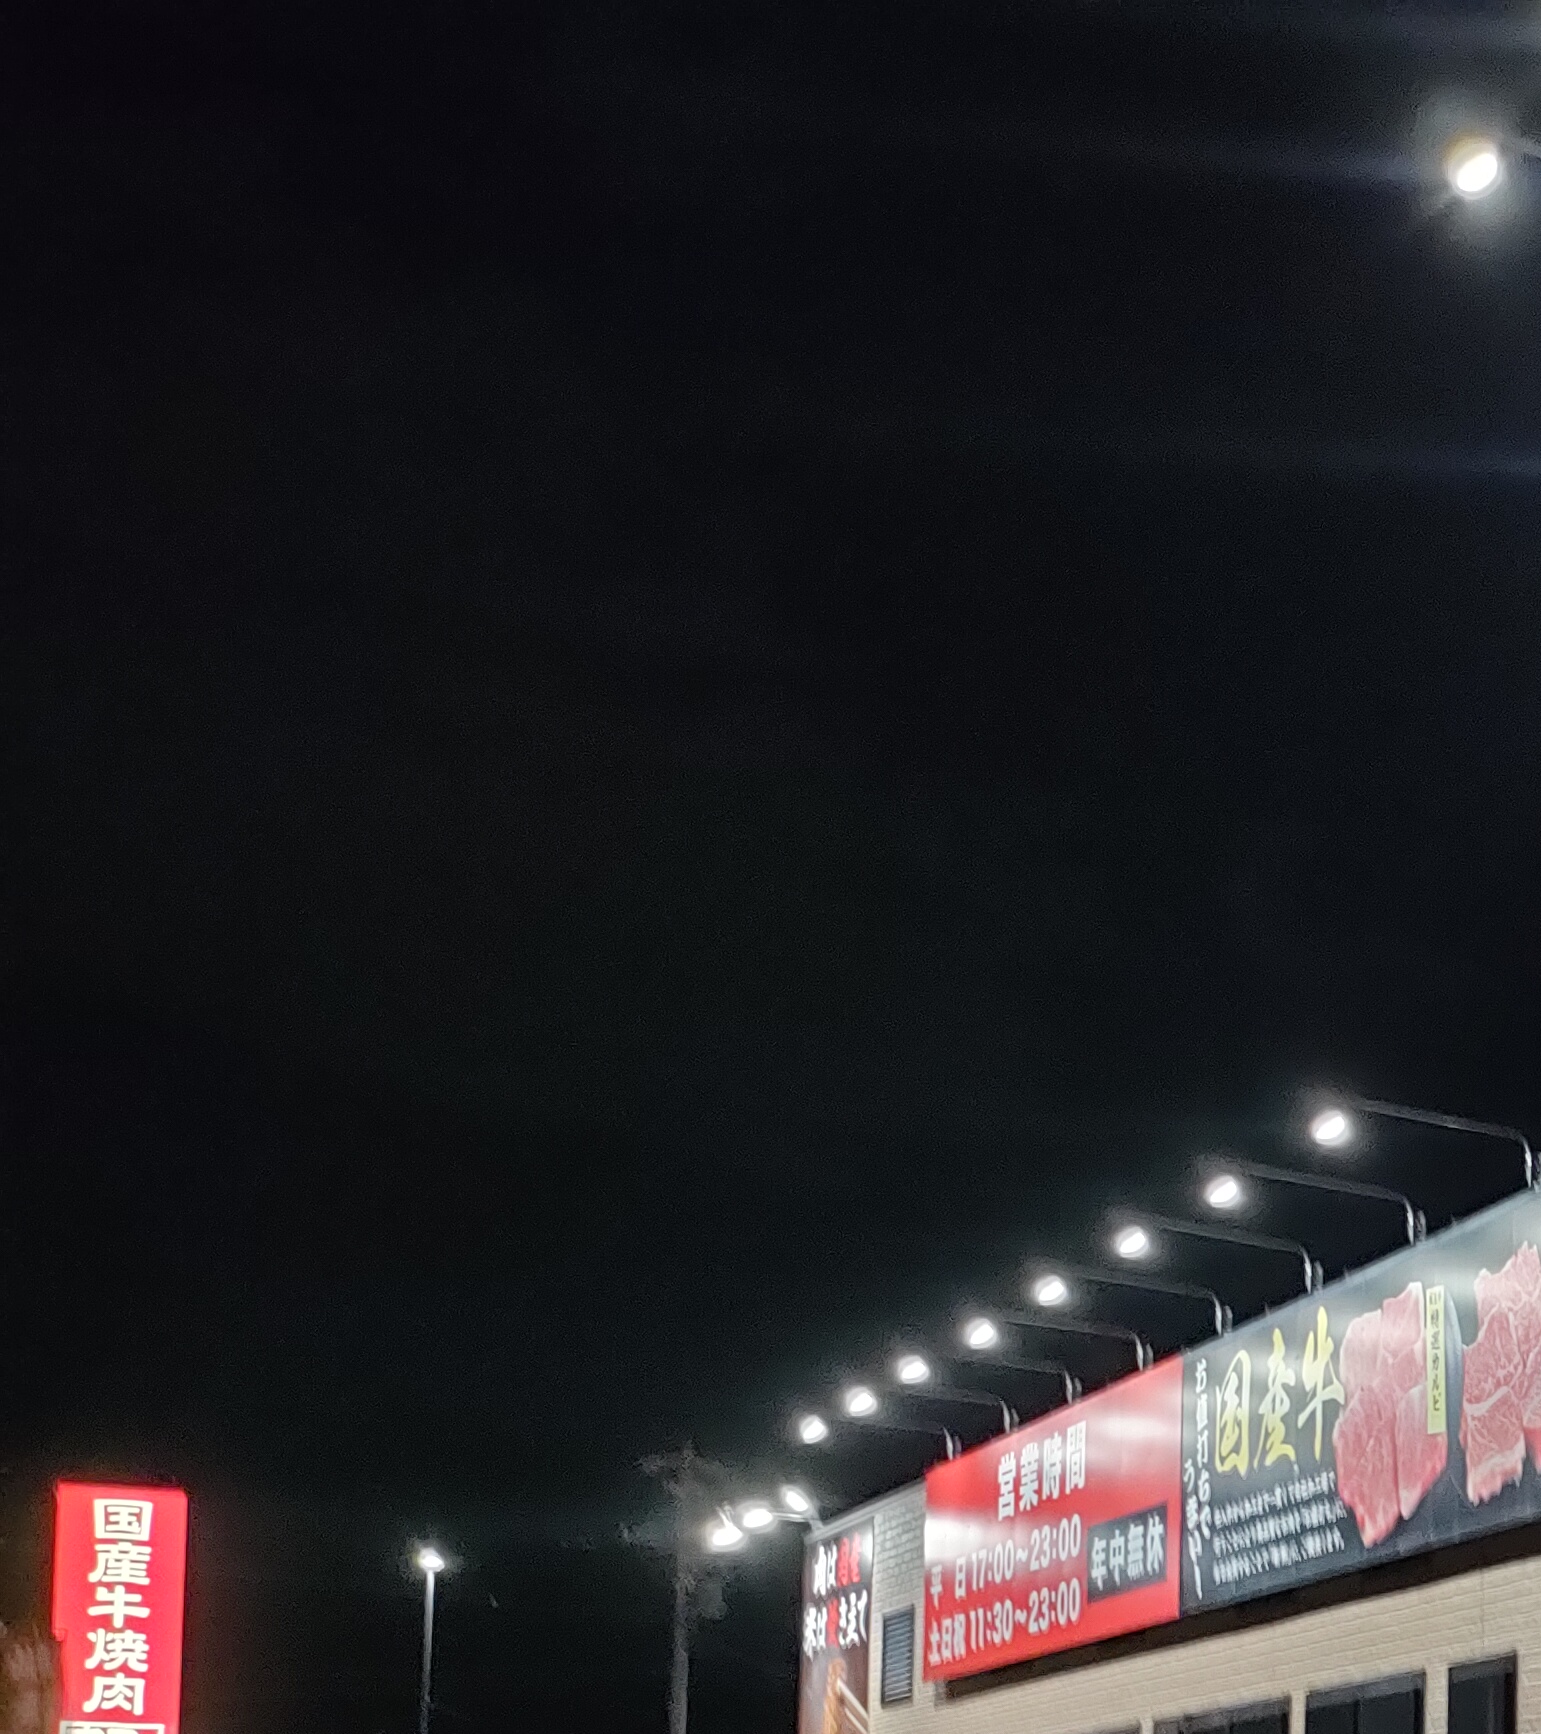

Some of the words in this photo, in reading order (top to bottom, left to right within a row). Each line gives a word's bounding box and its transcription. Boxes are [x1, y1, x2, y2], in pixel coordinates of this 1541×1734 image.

[1214, 1306, 1345, 1480] 国産牛
[997, 1420, 1087, 1522] 営業時間
[82, 1498, 154, 1716] 国産牛焼肉
[1090, 1514, 1165, 1592] 年中無休
